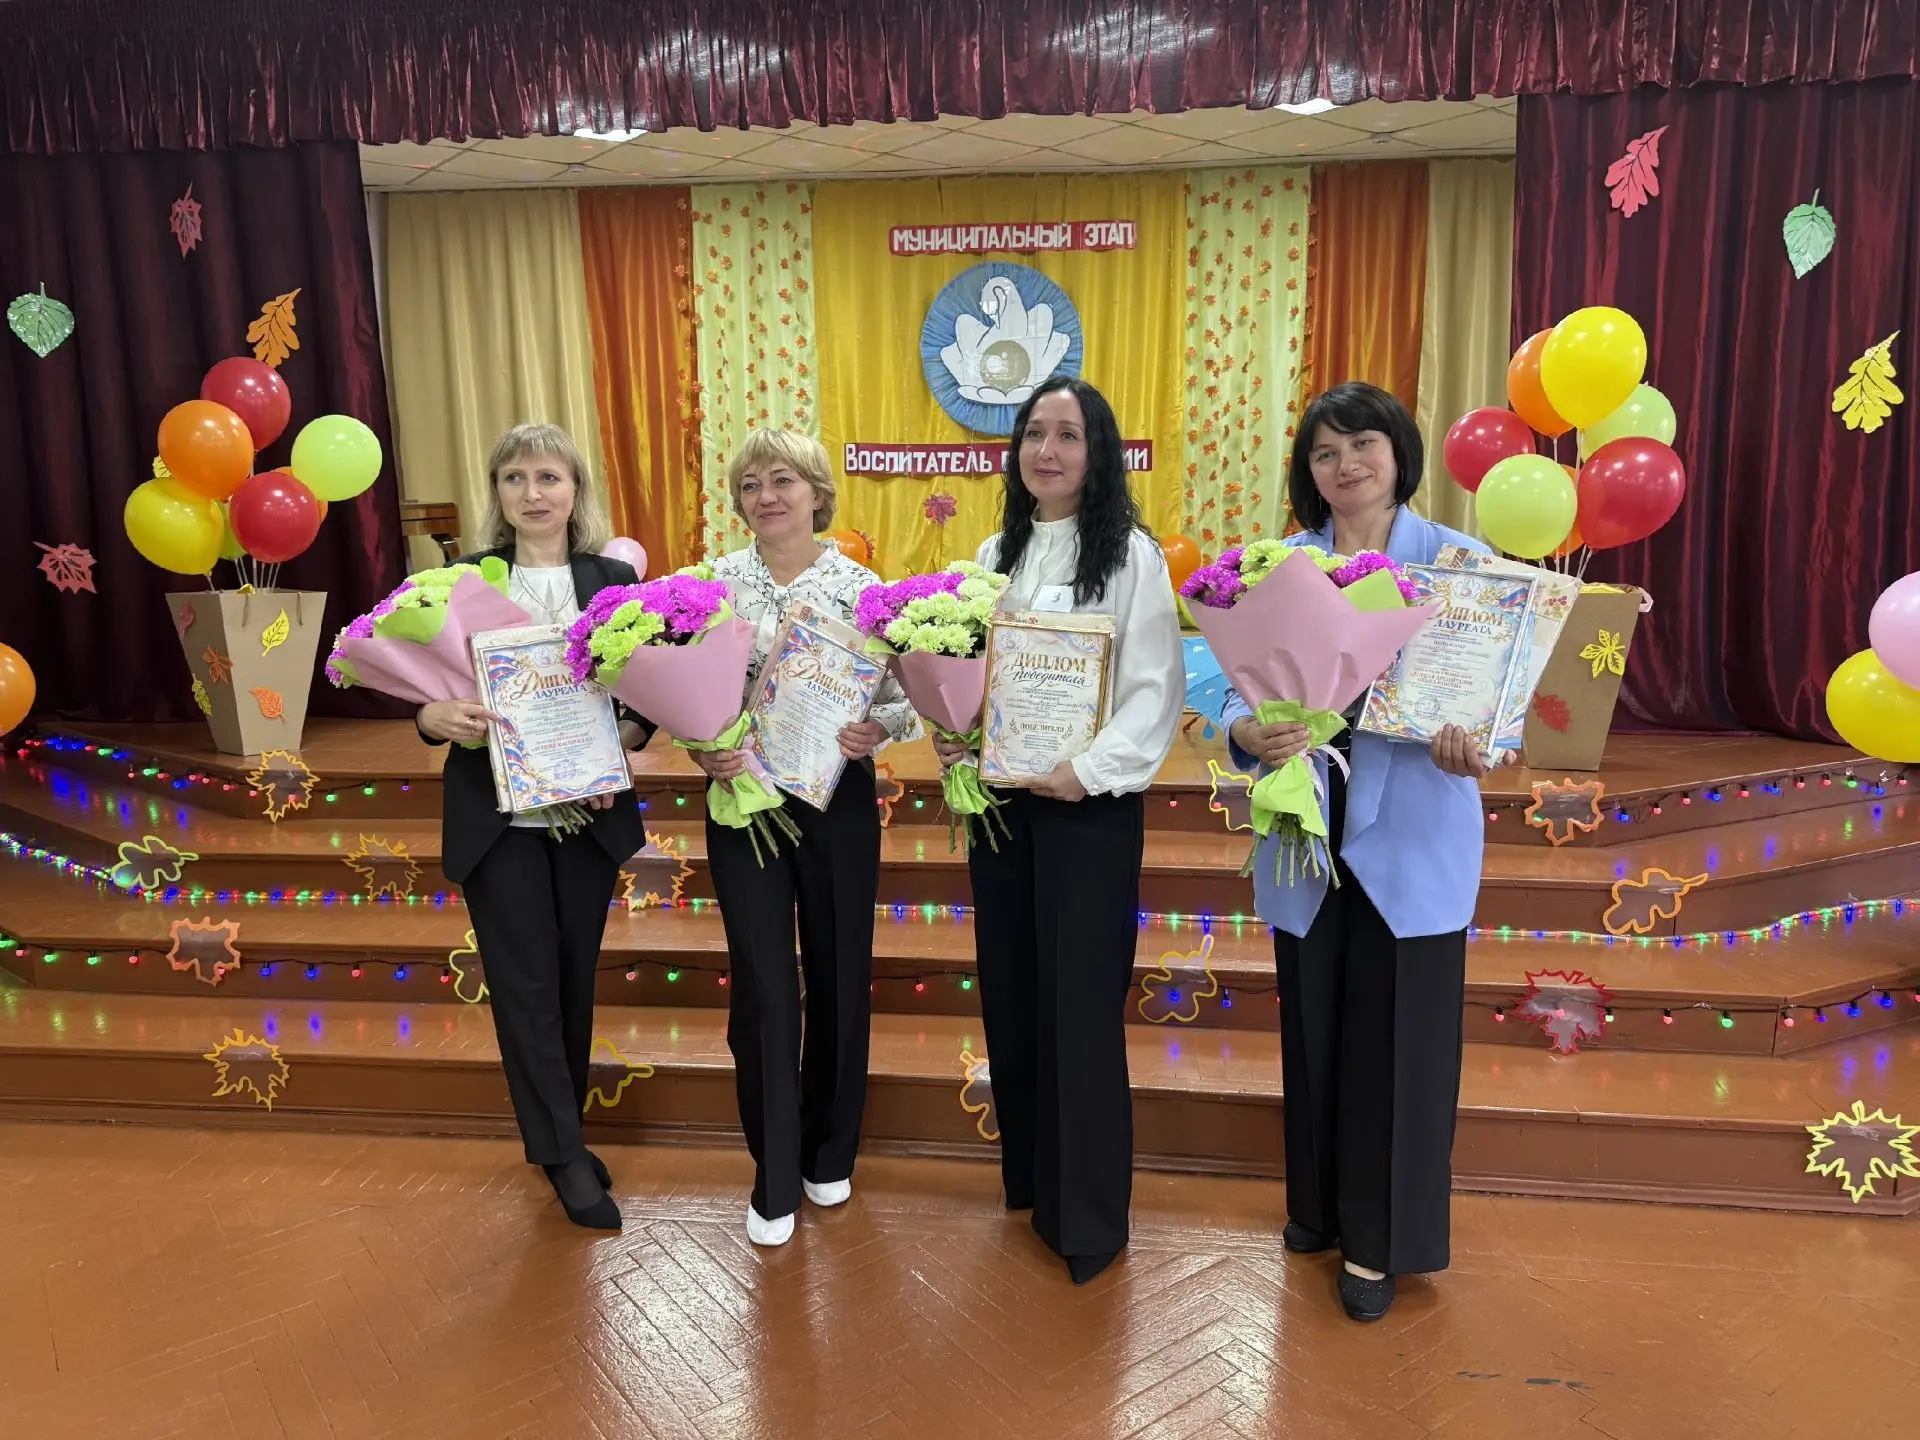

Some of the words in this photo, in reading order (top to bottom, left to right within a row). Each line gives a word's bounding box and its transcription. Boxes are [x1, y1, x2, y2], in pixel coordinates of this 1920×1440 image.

[893, 223, 1072, 252] МУНИЦИПАЛЬНЫЙ
[1084, 222, 1134, 247] ЭТАП
[845, 443, 993, 473] ВОСПИТАТЕЛЬ
[1433, 619, 1492, 635] ЛАУРЕАТА
[1014, 652, 1087, 673] ДИПЛОМ
[510, 670, 577, 700] ДИПЛО
[533, 683, 588, 700] ЛАУРЕАТА
[805, 681, 846, 706] ЛАУРЕАТА
